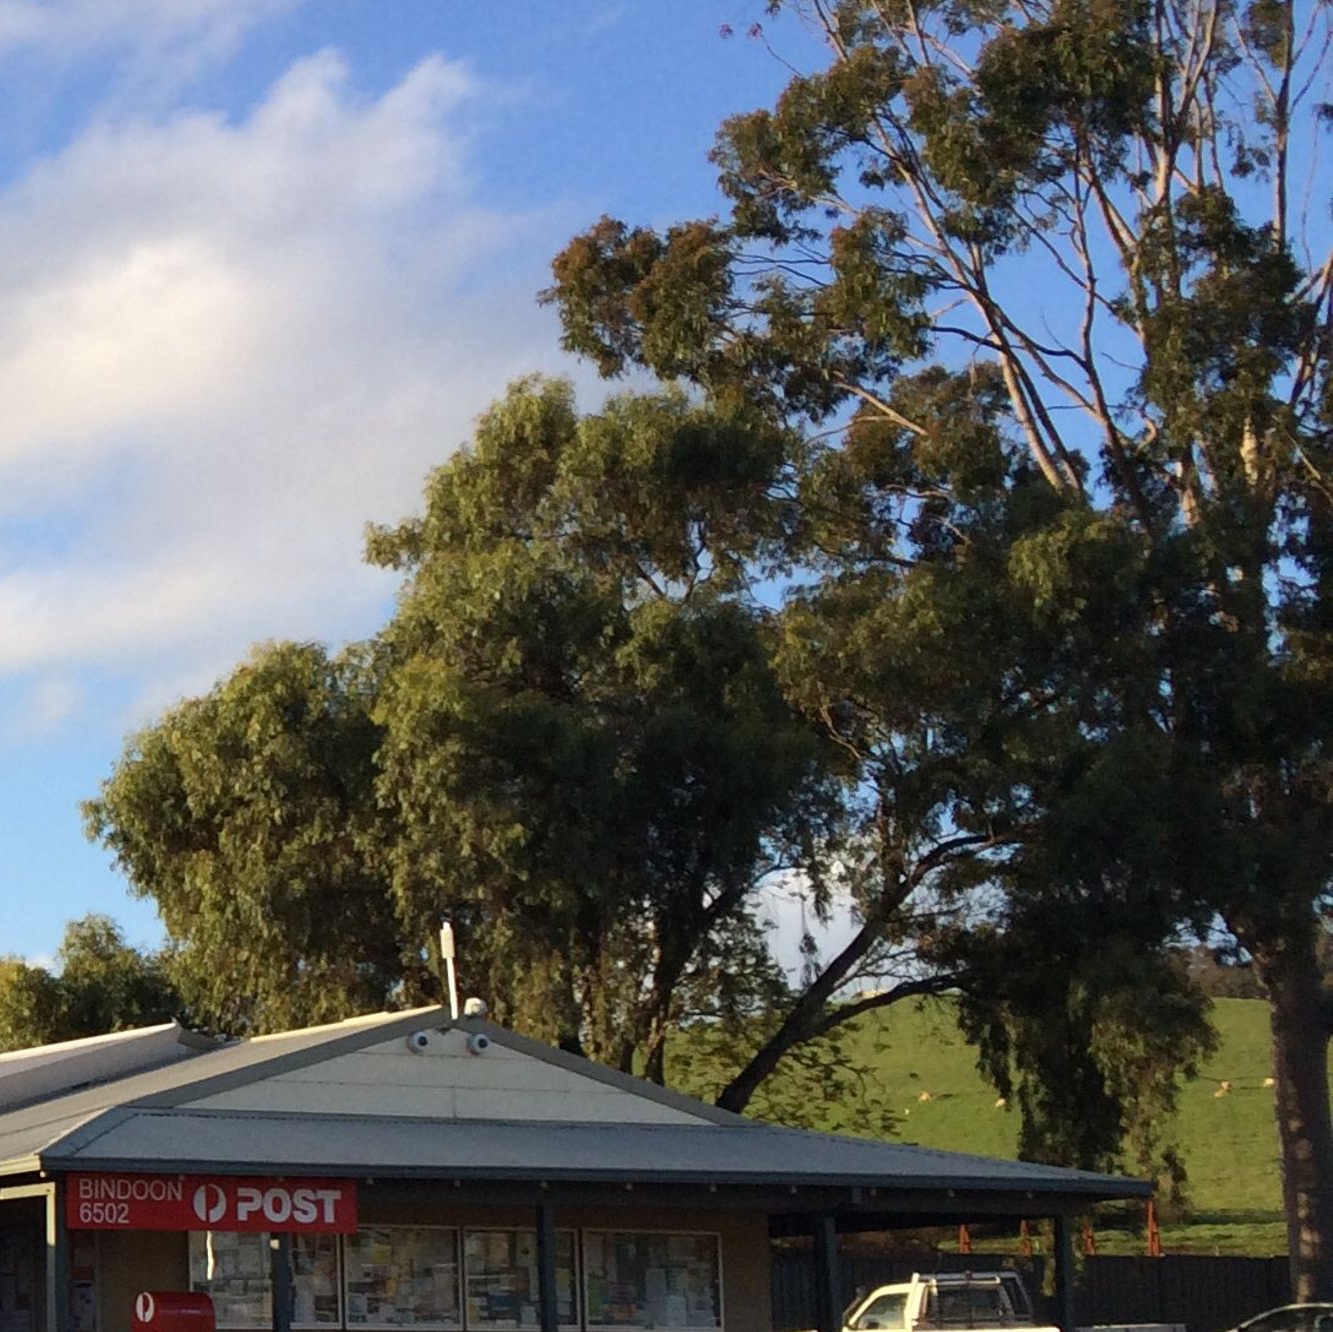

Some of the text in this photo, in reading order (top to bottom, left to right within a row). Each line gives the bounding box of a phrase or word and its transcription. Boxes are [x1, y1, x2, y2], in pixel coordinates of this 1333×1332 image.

[79, 1178, 341, 1224] BINDOON POST
[79, 1202, 130, 1224] 6502
